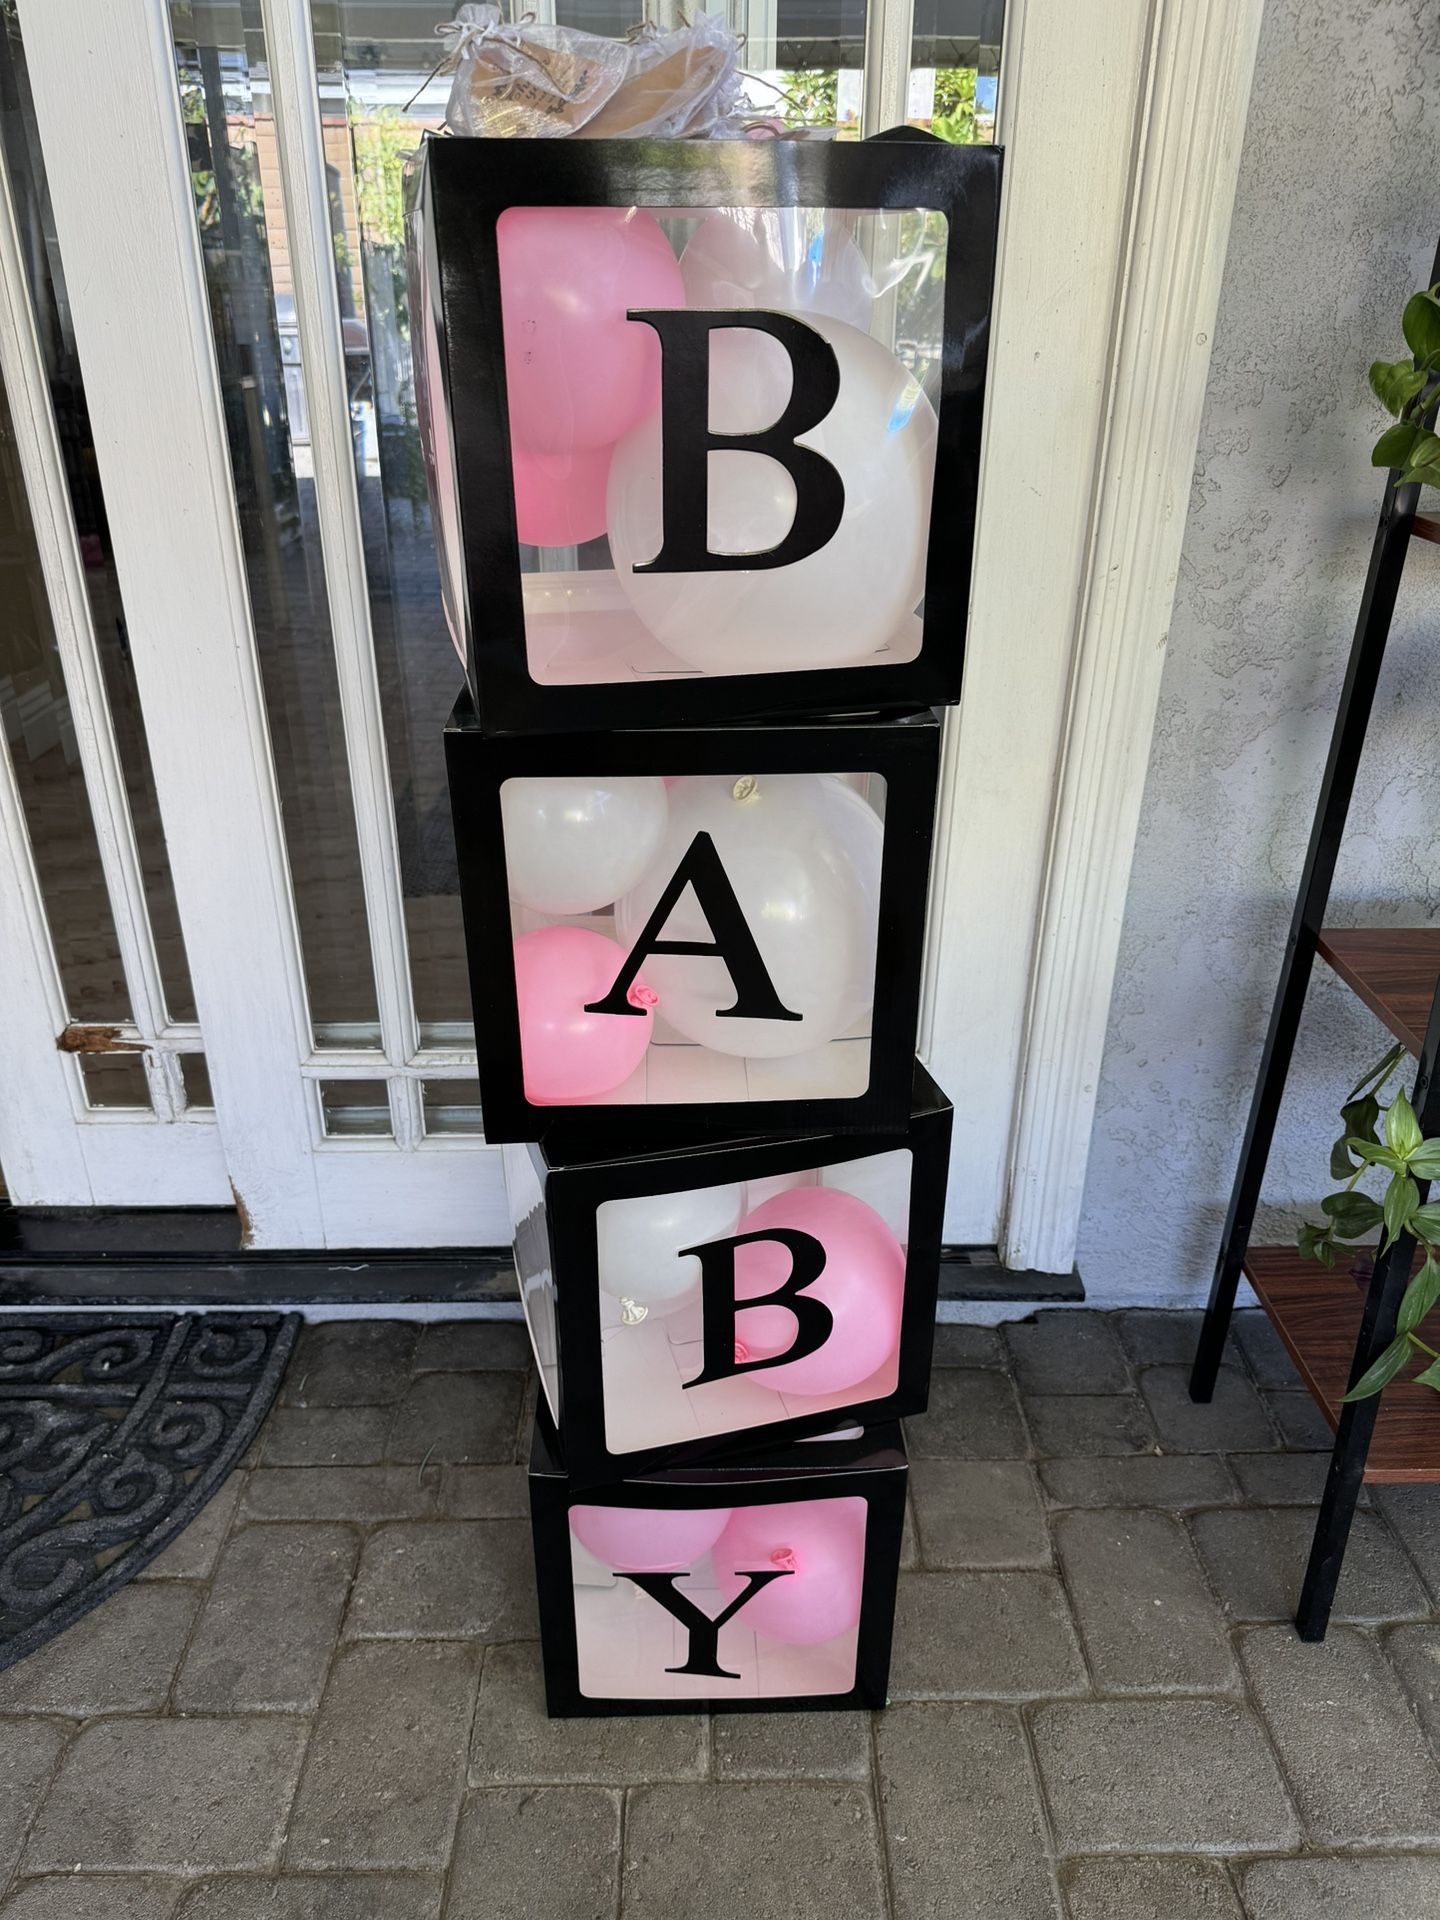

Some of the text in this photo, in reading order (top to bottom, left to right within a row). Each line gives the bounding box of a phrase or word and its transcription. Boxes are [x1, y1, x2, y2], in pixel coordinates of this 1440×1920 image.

[626, 308, 845, 574] B
[583, 830, 803, 1021] A
[678, 1227, 833, 1389] B
[612, 1570, 795, 1679] Y
